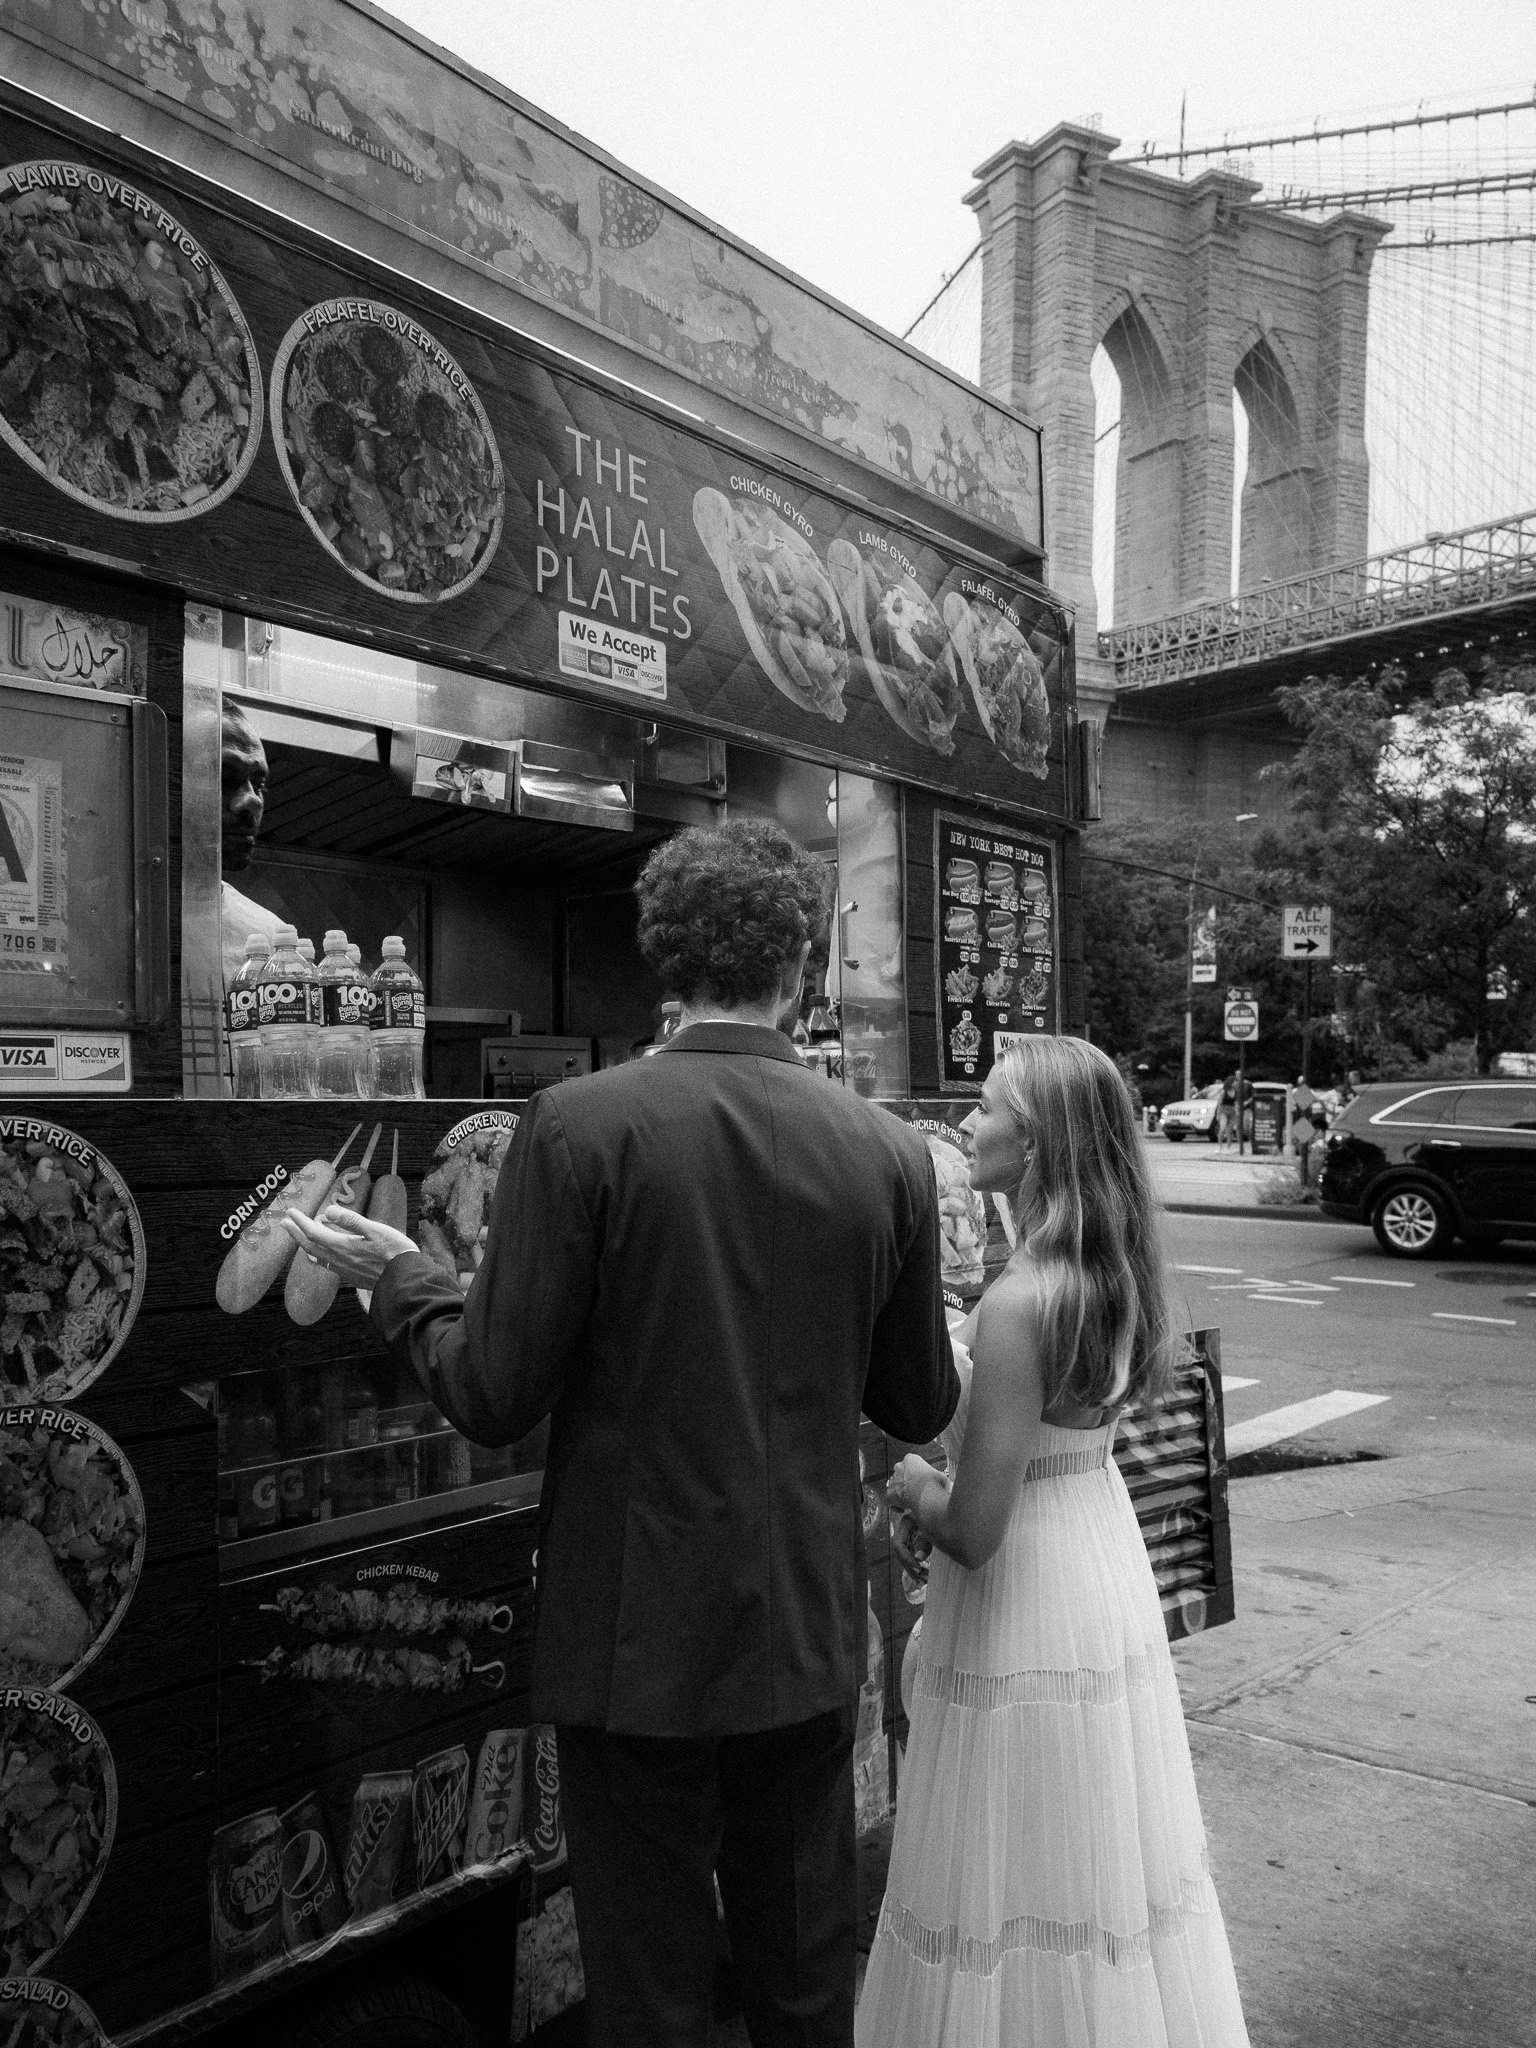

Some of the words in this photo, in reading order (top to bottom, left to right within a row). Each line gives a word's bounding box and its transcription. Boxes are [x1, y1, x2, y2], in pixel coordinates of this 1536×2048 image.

[287, 98, 387, 161] Sauerkraut
[390, 151, 424, 184] Dog
[8, 165, 80, 193] LAMB
[86, 172, 152, 219] OVER
[156, 212, 209, 272] RICE
[302, 301, 380, 333] FALAFEL
[384, 311, 432, 353] OVER
[434, 350, 472, 401] RICE
[565, 425, 648, 504] THE
[730, 475, 781, 508] CHICKEN
[783, 500, 814, 538] GYRO
[537, 479, 679, 577] HALAL
[858, 530, 888, 553] LAMB
[889, 546, 917, 579] GYRO
[536, 545, 692, 640] PLATES
[961, 579, 997, 604] FALAFEL
[997, 597, 1020, 627] GYRO
[569, 619, 597, 644] We
[602, 630, 657, 663] Accept
[617, 665, 635, 679] VISA
[641, 670, 662, 682] DISCOVER
[950, 831, 967, 847] NEW
[969, 836, 991, 853] YORK
[993, 842, 1014, 858] BEST
[1015, 847, 1030, 863] HOT
[1030, 852, 1045, 867] DOG
[1286, 925, 1329, 936] TRAFFIC
[1294, 910, 1321, 923] ALL
[3, 933, 36, 950] 706
[1230, 1009, 1239, 1017] DO
[1240, 1009, 1251, 1017] NOT
[1232, 1025, 1250, 1033] ENTER
[0, 1049, 47, 1066] VISA
[64, 1046, 121, 1058] DISCOVER
[46, 1127, 96, 1167] RICE
[447, 1113, 499, 1148] CHICKEN
[501, 1113, 520, 1131] WI
[940, 1123, 962, 1145] GYRO
[220, 1193, 258, 1240] CORN
[256, 1164, 288, 1201] DOG
[942, 1289, 963, 1310] GYRO
[40, 1409, 88, 1440] RICE
[356, 1564, 404, 1581] CHICKEN
[405, 1564, 439, 1583] KEBAB
[27, 1692, 92, 1743] SALAD
[481, 1744, 496, 1791] Diet
[291, 1877, 336, 1930] pepsi
[1, 1980, 70, 2010] SALAD
